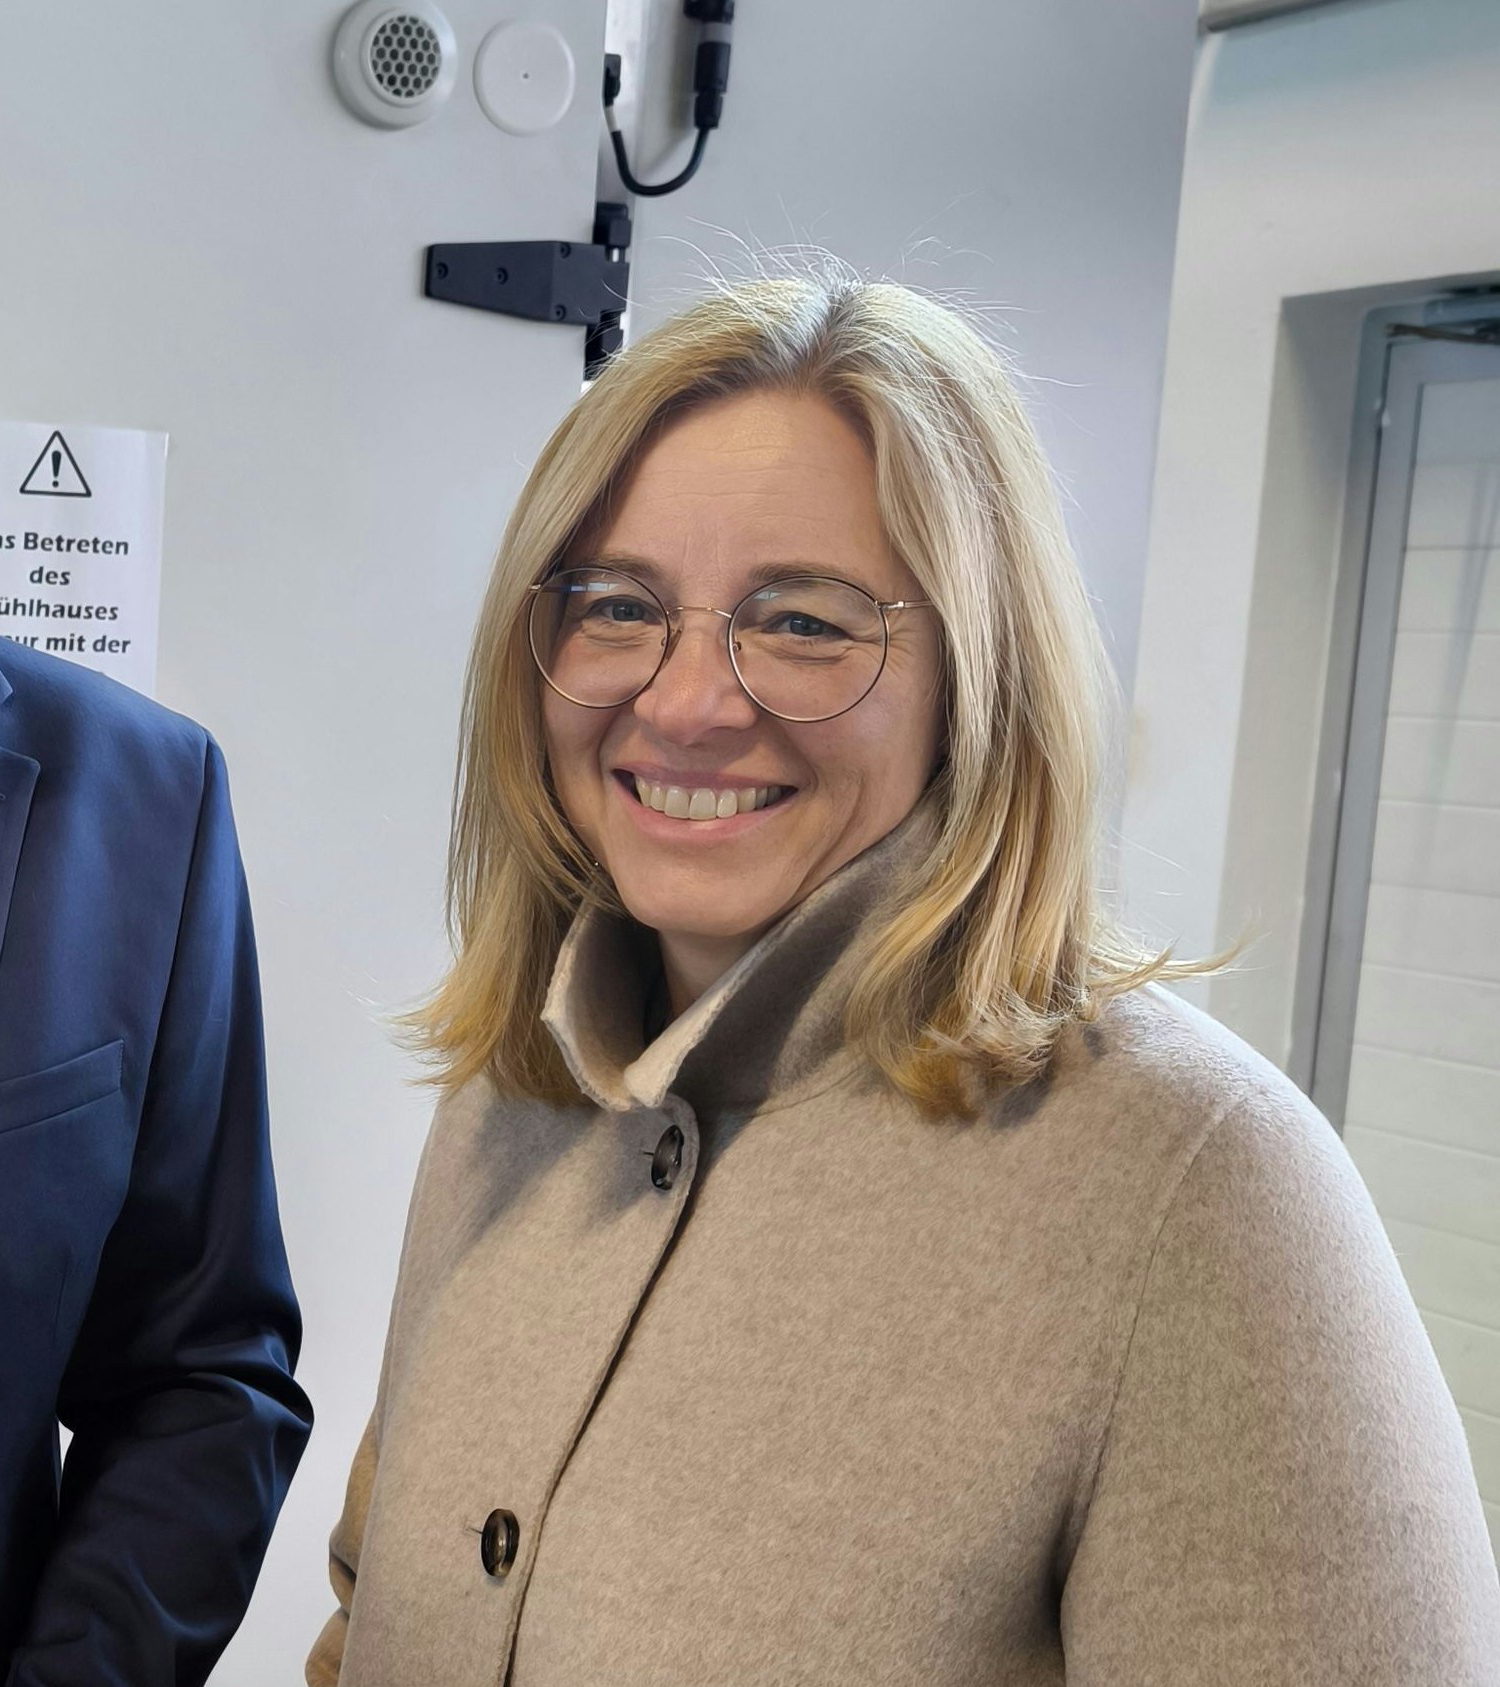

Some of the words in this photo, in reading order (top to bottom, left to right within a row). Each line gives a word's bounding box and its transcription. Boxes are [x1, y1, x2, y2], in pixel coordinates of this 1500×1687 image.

[23, 531, 129, 555] Betreten
[29, 566, 71, 586] des
[3, 634, 38, 649] ur
[45, 633, 86, 652] mit
[92, 634, 131, 653] der
